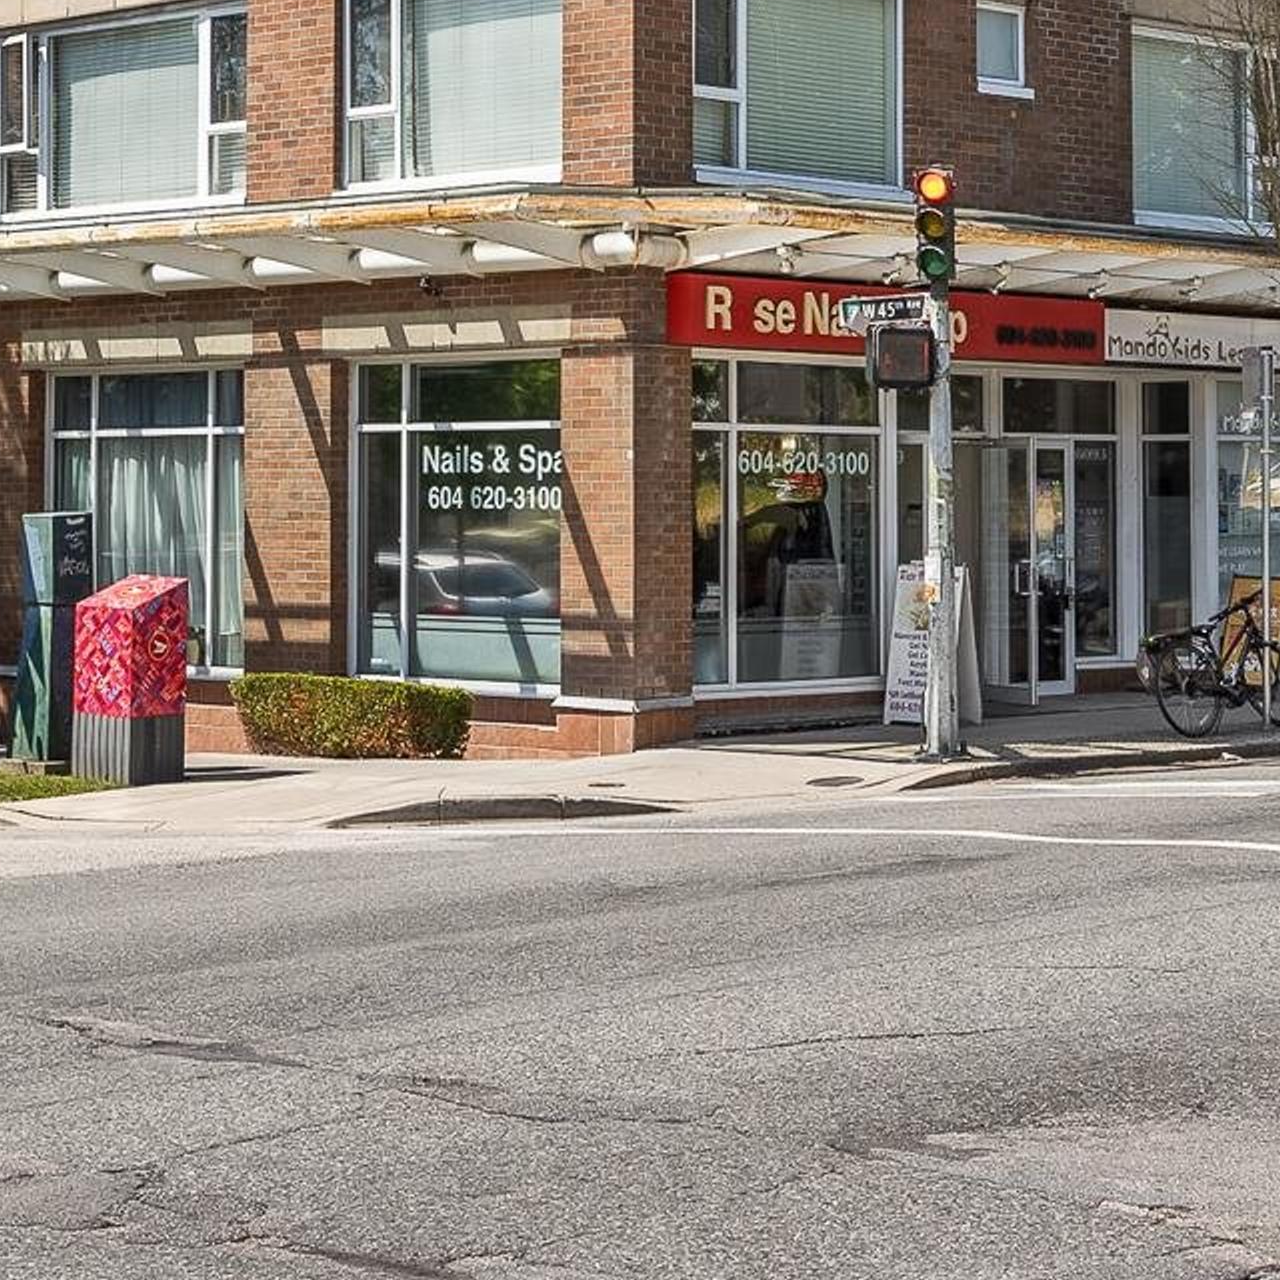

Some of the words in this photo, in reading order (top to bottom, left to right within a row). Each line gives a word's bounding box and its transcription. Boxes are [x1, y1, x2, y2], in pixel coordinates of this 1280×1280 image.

[705, 285, 796, 334] Rse
[861, 303, 875, 318] W
[422, 445, 485, 474] Nails
[491, 445, 511, 474] &
[519, 443, 562, 482] Spa
[738, 449, 870, 475] 604-620-3100
[428, 485, 464, 510] 604
[471, 485, 563, 510] 620-3100
